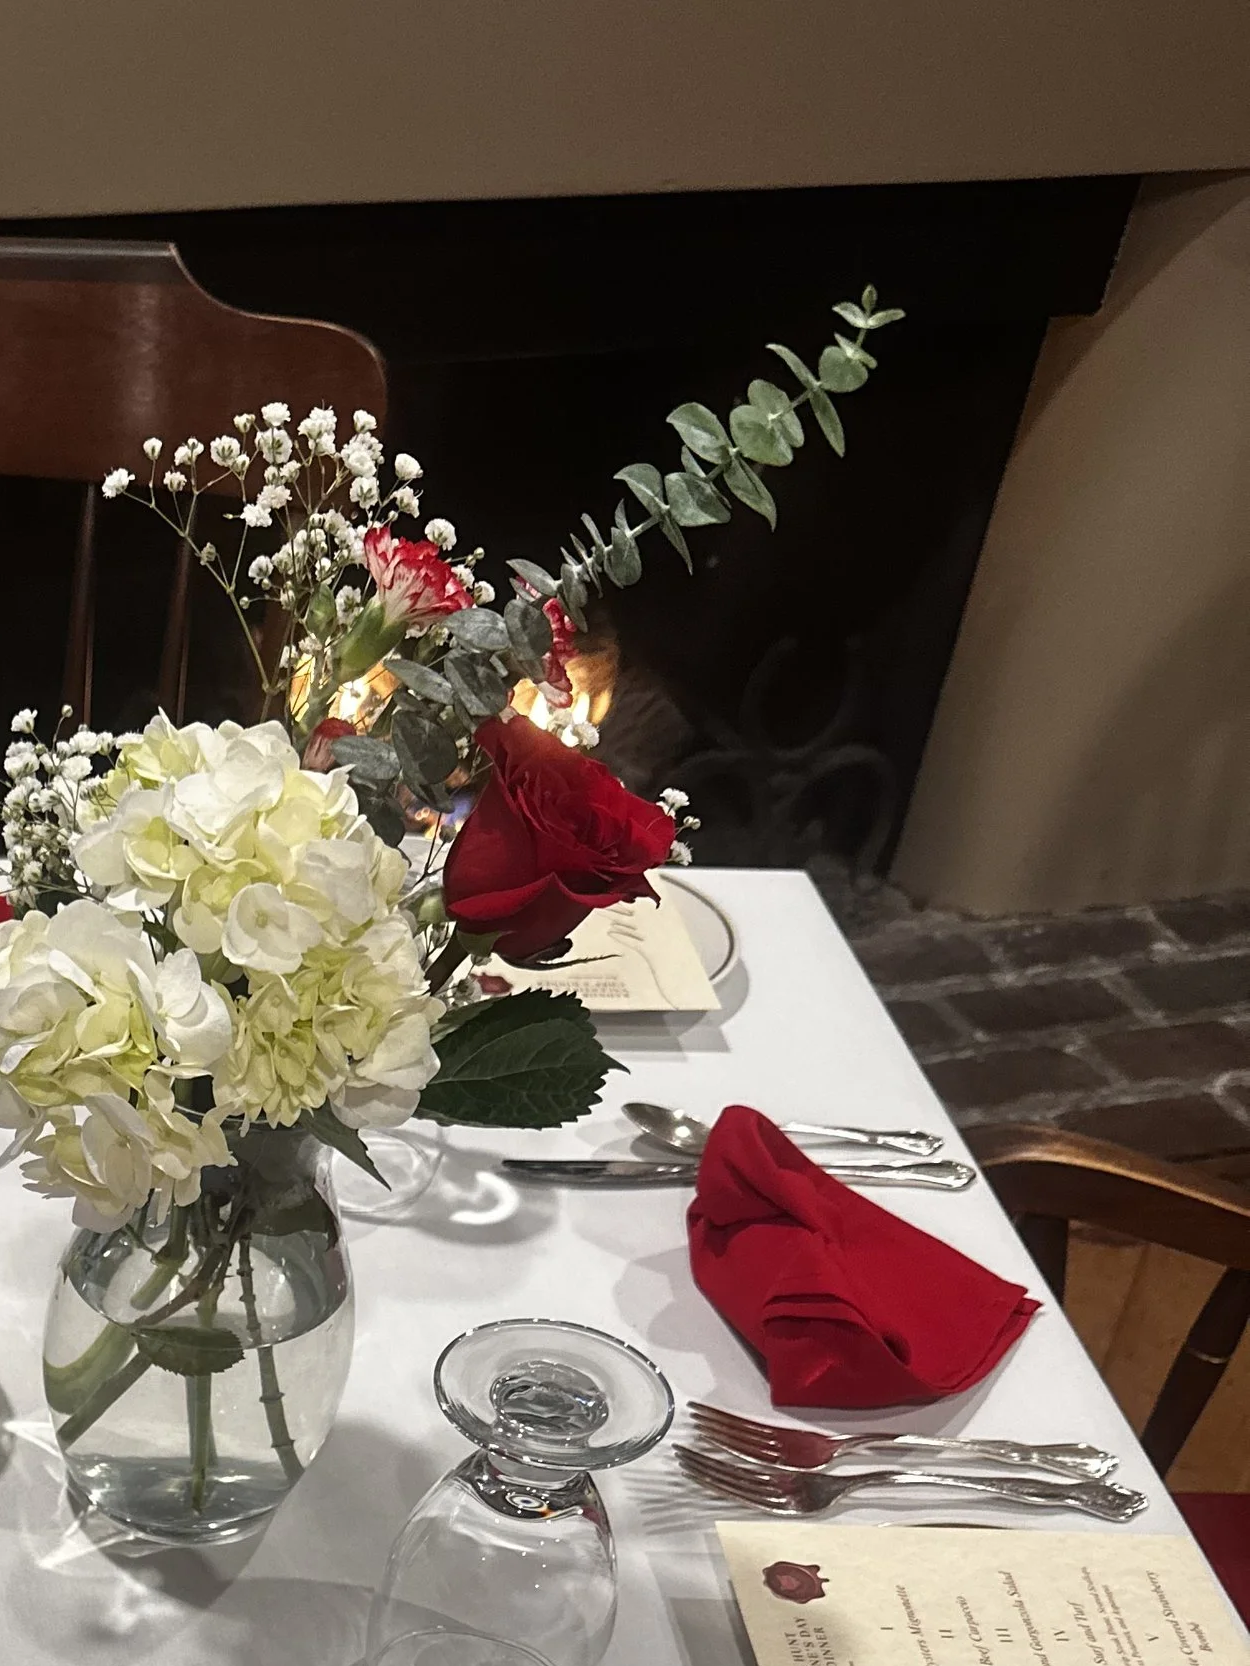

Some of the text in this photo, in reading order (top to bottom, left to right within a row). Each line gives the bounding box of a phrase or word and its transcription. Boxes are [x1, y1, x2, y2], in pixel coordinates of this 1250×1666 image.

[997, 1570, 1021, 1598] Salad
[793, 1616, 811, 1638] DAY
[938, 1629, 954, 1639] II
[995, 1628, 1013, 1642] III
[1051, 1627, 1070, 1642] IV
[1067, 1600, 1108, 1666] Surf and Turf
[784, 1632, 805, 1662] HUNT
[972, 1643, 994, 1666] Beef
